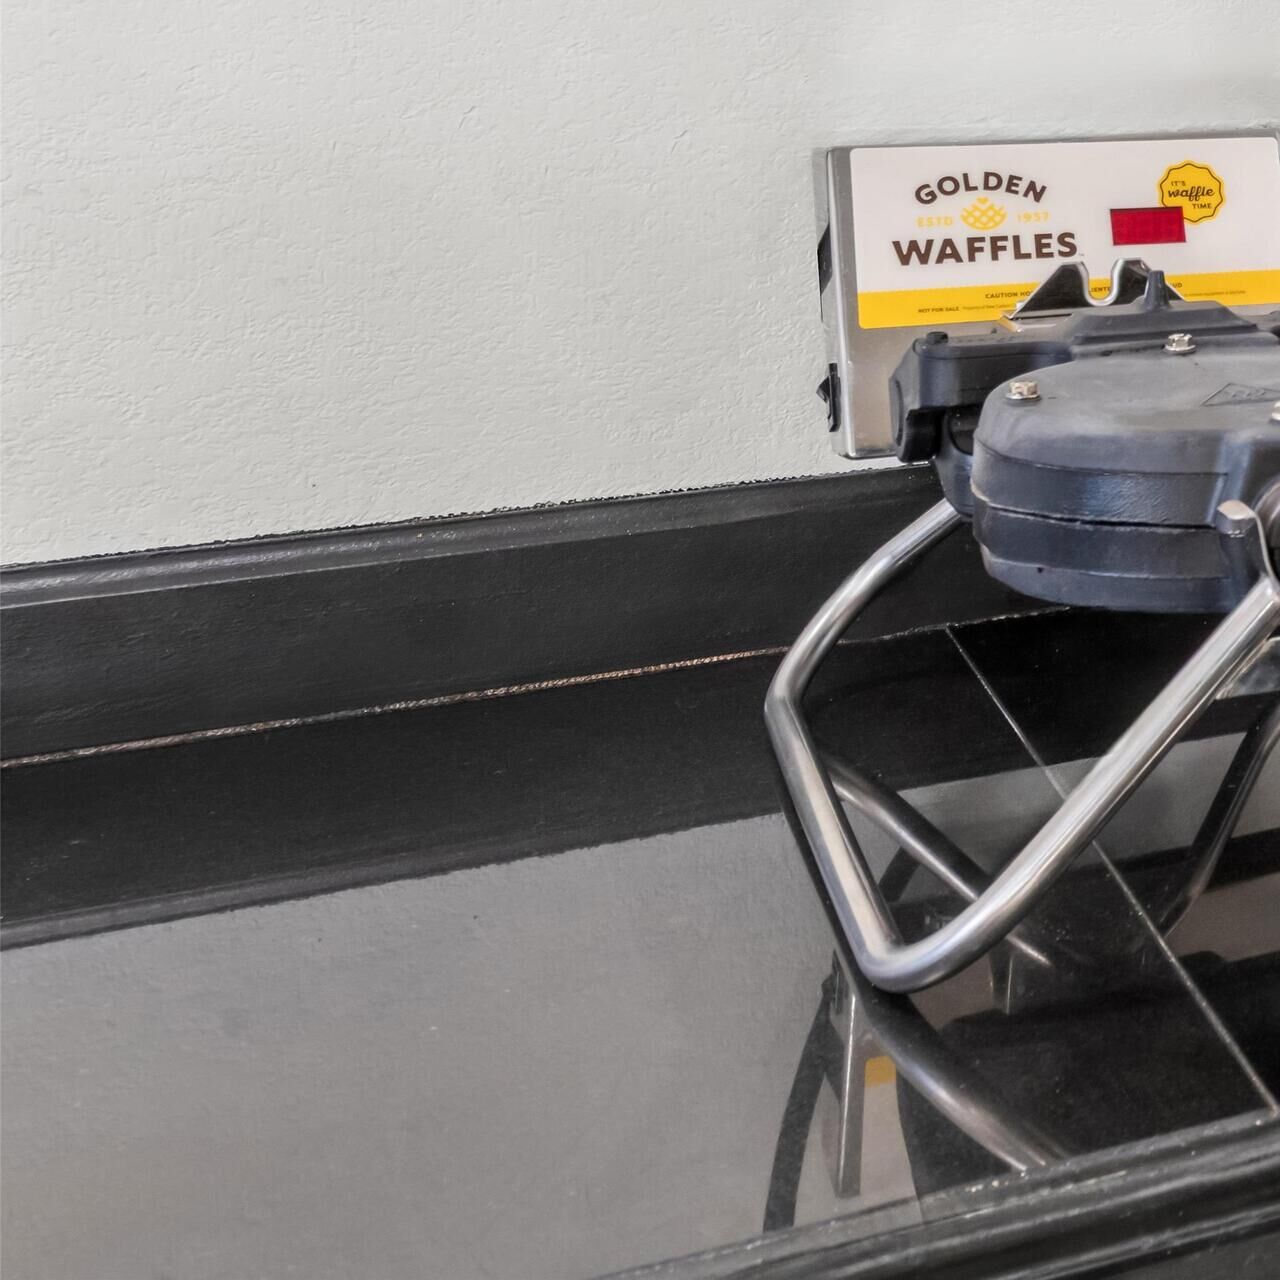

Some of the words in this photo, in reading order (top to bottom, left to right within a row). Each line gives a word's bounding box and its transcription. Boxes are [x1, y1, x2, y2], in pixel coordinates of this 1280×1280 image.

[915, 171, 1047, 205] GOLDEN
[1168, 185, 1215, 202] waffle
[917, 216, 953, 228] ESTD
[892, 232, 1078, 266] WAFFLES
